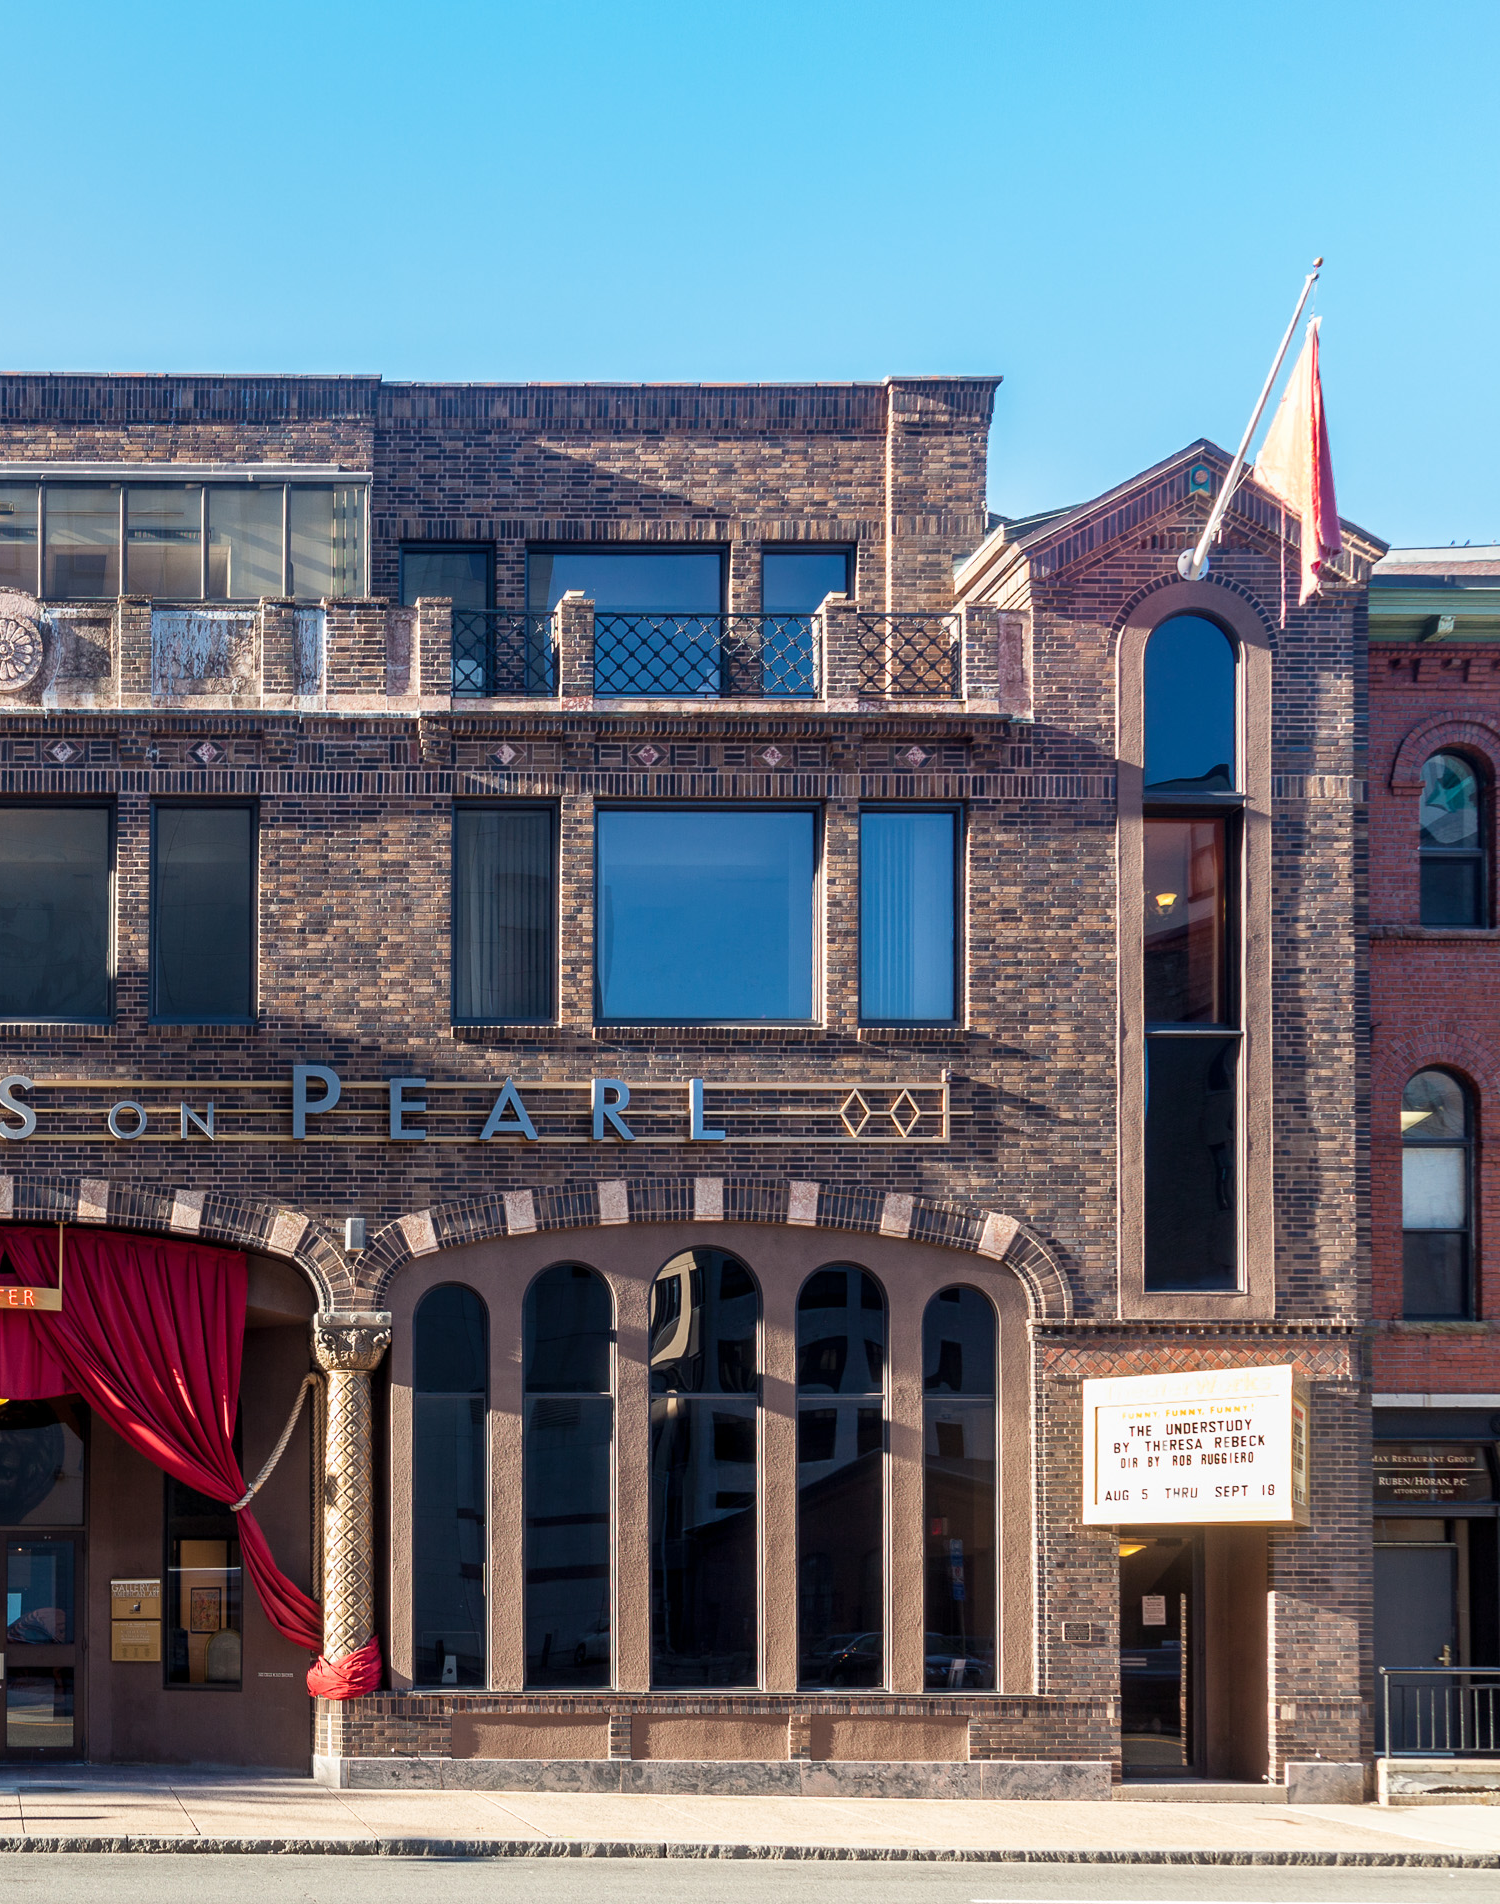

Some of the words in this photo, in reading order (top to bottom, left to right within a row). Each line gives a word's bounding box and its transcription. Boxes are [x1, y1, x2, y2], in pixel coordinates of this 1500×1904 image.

[108, 1101, 215, 1141] ON
[292, 1064, 726, 1142] PEARL
[1165, 1407, 1205, 1418] FUNNY,
[1129, 1425, 1152, 1437] THE
[1166, 1419, 1252, 1435] UNDERSTUDY
[1113, 1442, 1130, 1454] BY
[1145, 1438, 1203, 1452] THERESA
[1214, 1435, 1266, 1448] REBECK
[1120, 1457, 1138, 1469] DIR
[1147, 1456, 1160, 1468] BY
[1172, 1455, 1192, 1466] ROB
[1201, 1451, 1254, 1466] RUGGIERO
[1391, 1455, 1445, 1463] RESTAURANT
[1447, 1455, 1476, 1463] GROUP
[1453, 1478, 1469, 1486] P.C.
[1105, 1490, 1130, 1501] AUG
[1141, 1488, 1149, 1500] 5
[1165, 1487, 1198, 1499] THRU
[1215, 1484, 1249, 1498] SEPT
[1262, 1483, 1276, 1496] 18
[111, 1583, 150, 1592] GALLERY
